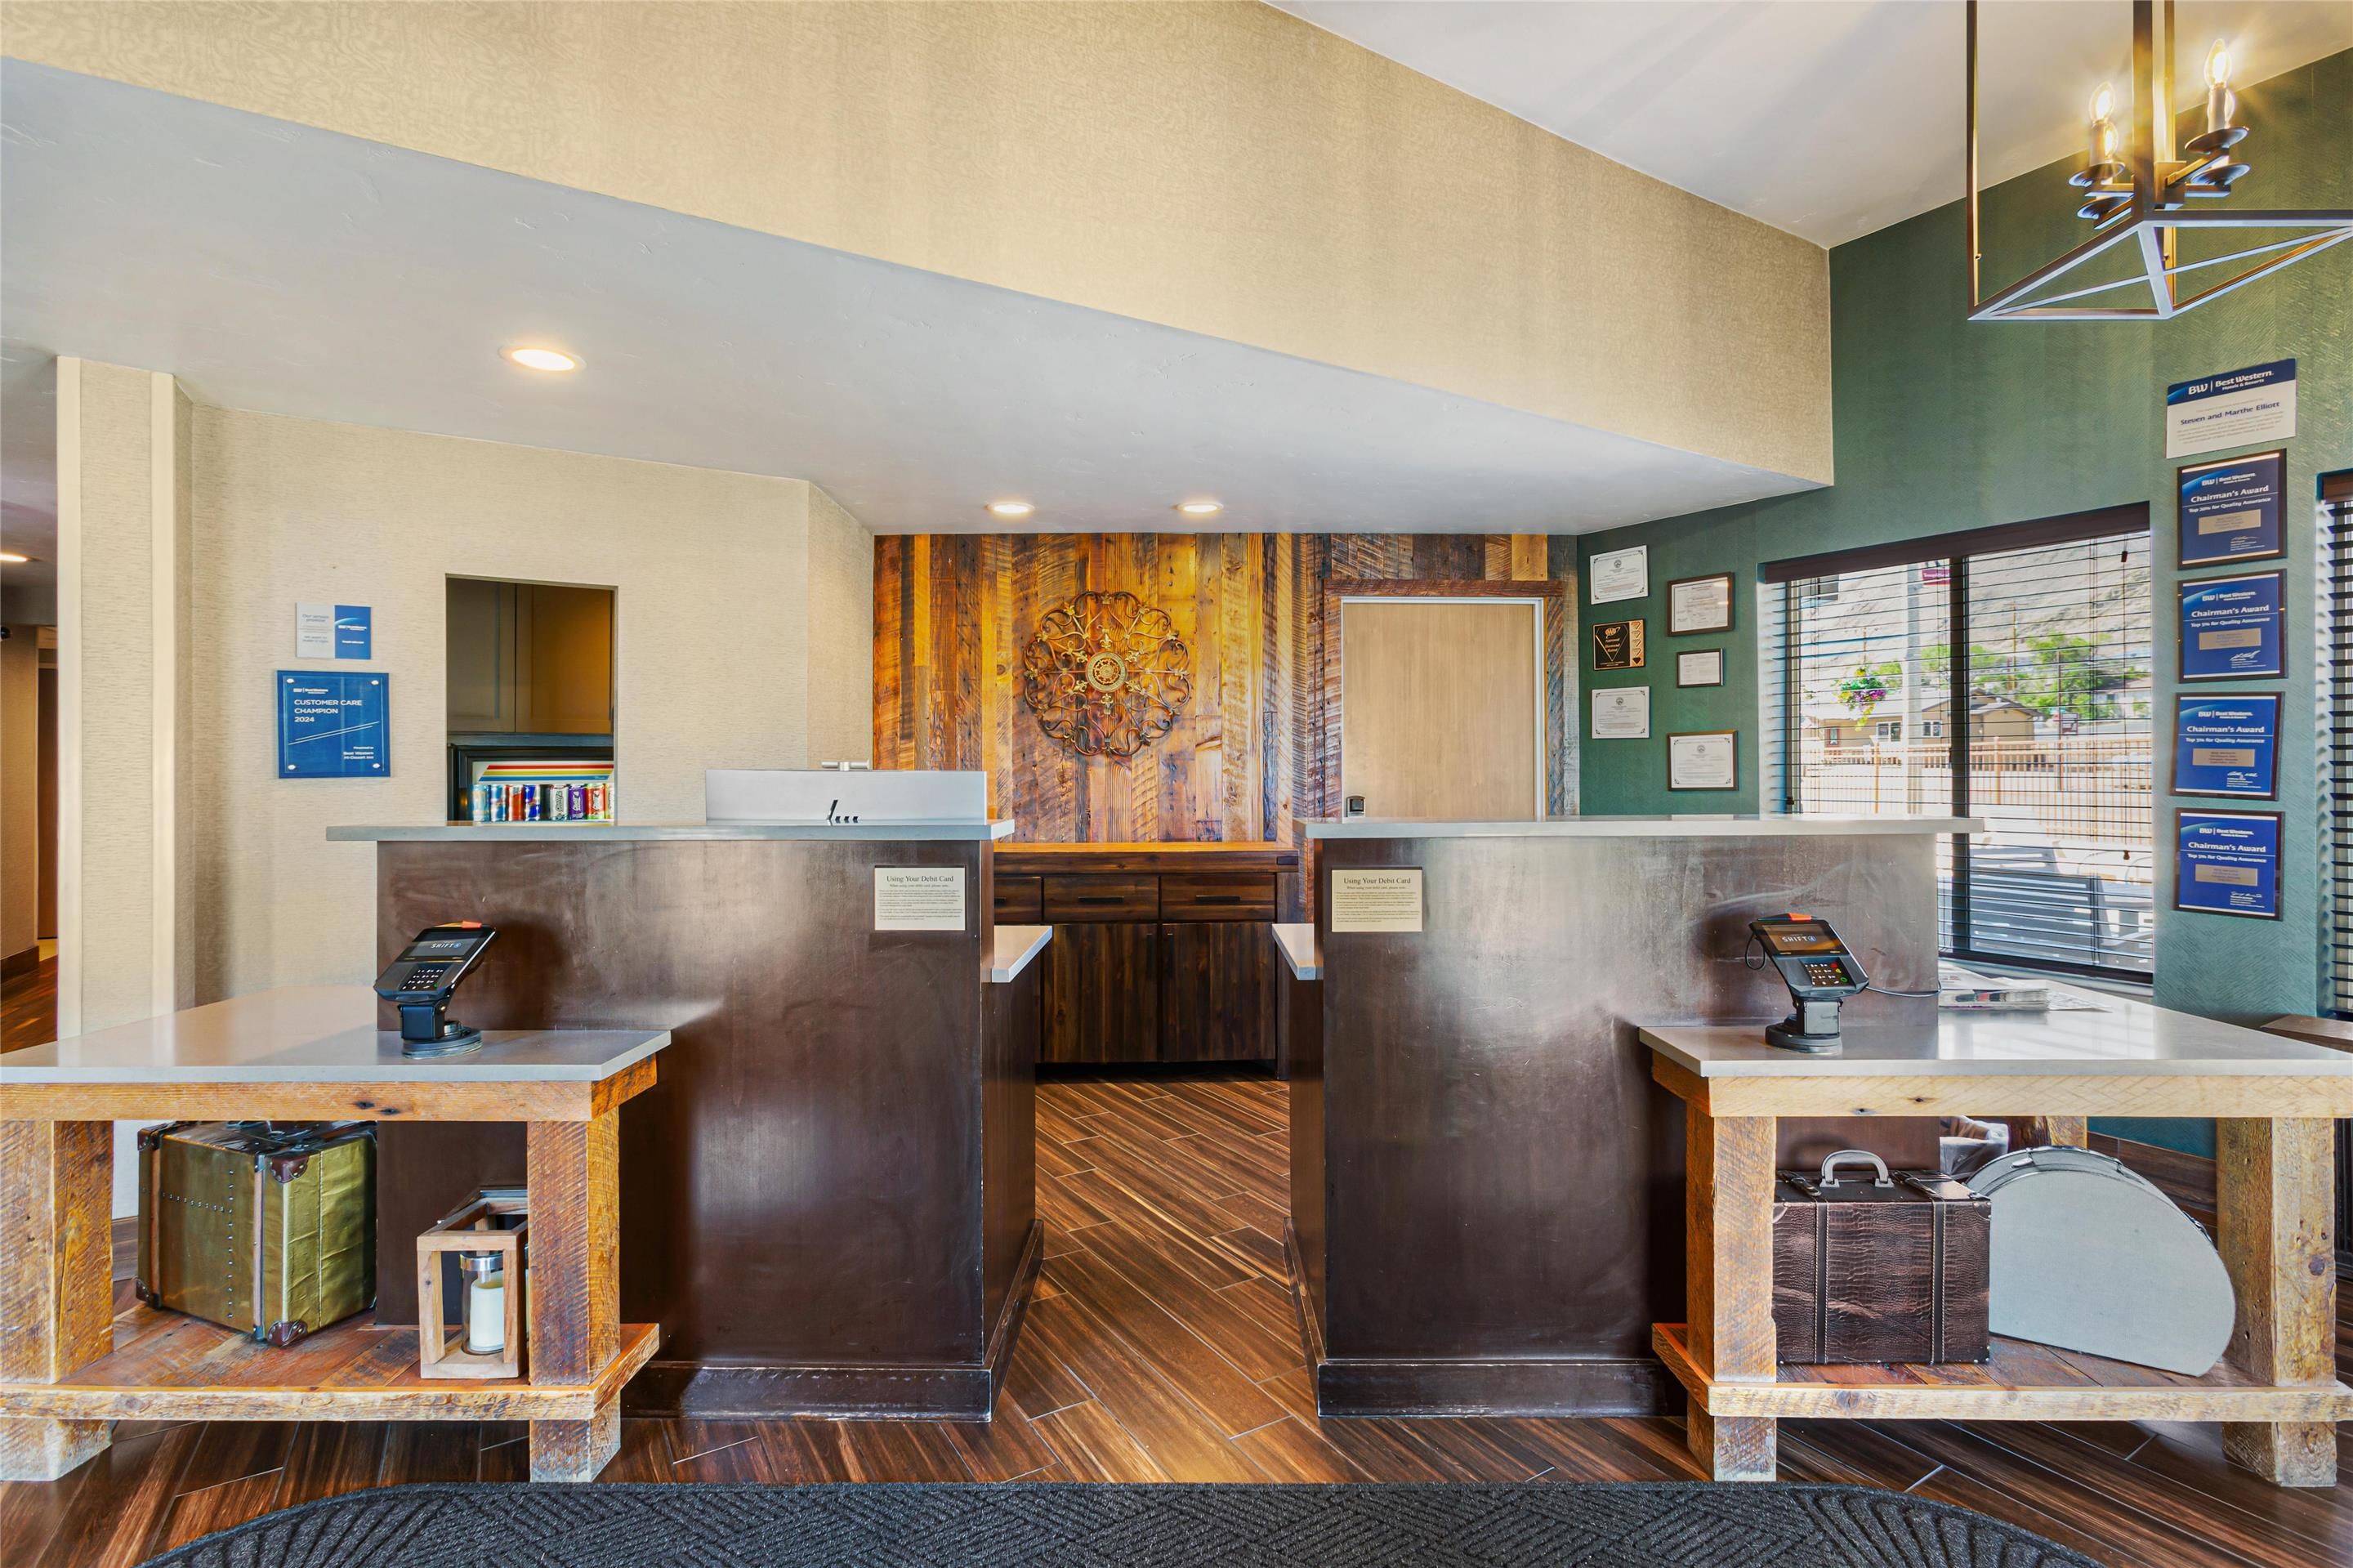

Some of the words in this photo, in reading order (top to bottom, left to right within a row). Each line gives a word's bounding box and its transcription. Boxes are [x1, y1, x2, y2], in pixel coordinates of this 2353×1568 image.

[2215, 377, 2235, 388] Best
[2235, 370, 2273, 382] Western
[2188, 383, 2208, 395] BW
[2180, 416, 2205, 425] Steven
[2208, 412, 2222, 420] and
[2225, 406, 2253, 417] Marthe
[2256, 401, 2280, 411] Elliott
[2190, 490, 2239, 503] Chairman's
[2240, 485, 2269, 495] Award
[2191, 608, 2239, 617] Chairman's
[2240, 605, 2270, 613] Award
[2188, 842, 2236, 851] Chairman's
[2237, 845, 2266, 853] Award
